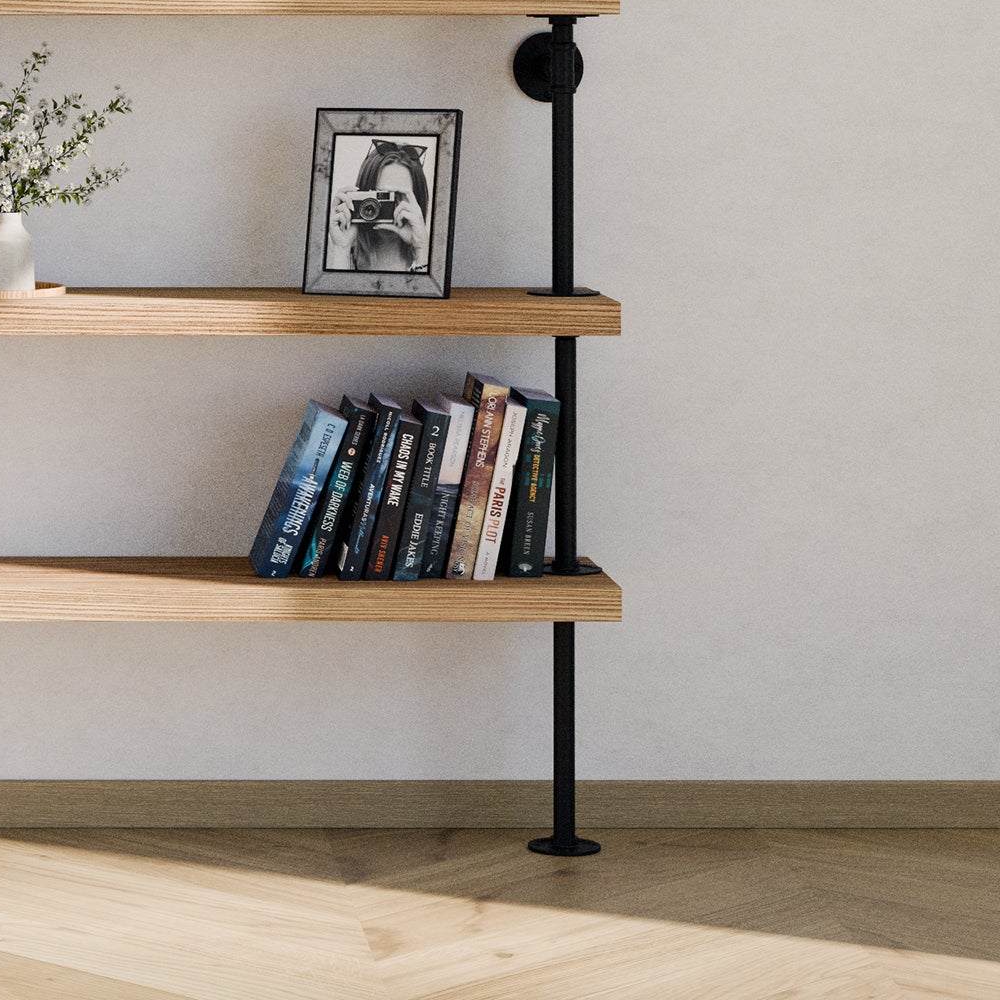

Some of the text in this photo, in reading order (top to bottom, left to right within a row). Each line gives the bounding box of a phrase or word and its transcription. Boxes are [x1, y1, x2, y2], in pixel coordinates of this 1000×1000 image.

[420, 442, 437, 489] BOOK TITLE
[475, 408, 494, 468] ANN STEPHENS
[321, 461, 353, 532] WEB OF DARKNESS
[386, 433, 414, 507] CHAOS IN MY WAKE
[529, 454, 541, 503] DETECTIVE AGENCY
[360, 483, 374, 525] AVENTURAS
[431, 492, 450, 556] NIGHT KEEPING
[486, 486, 506, 544] PARIS PLOT
[405, 513, 424, 569] EDDIE JAKES
